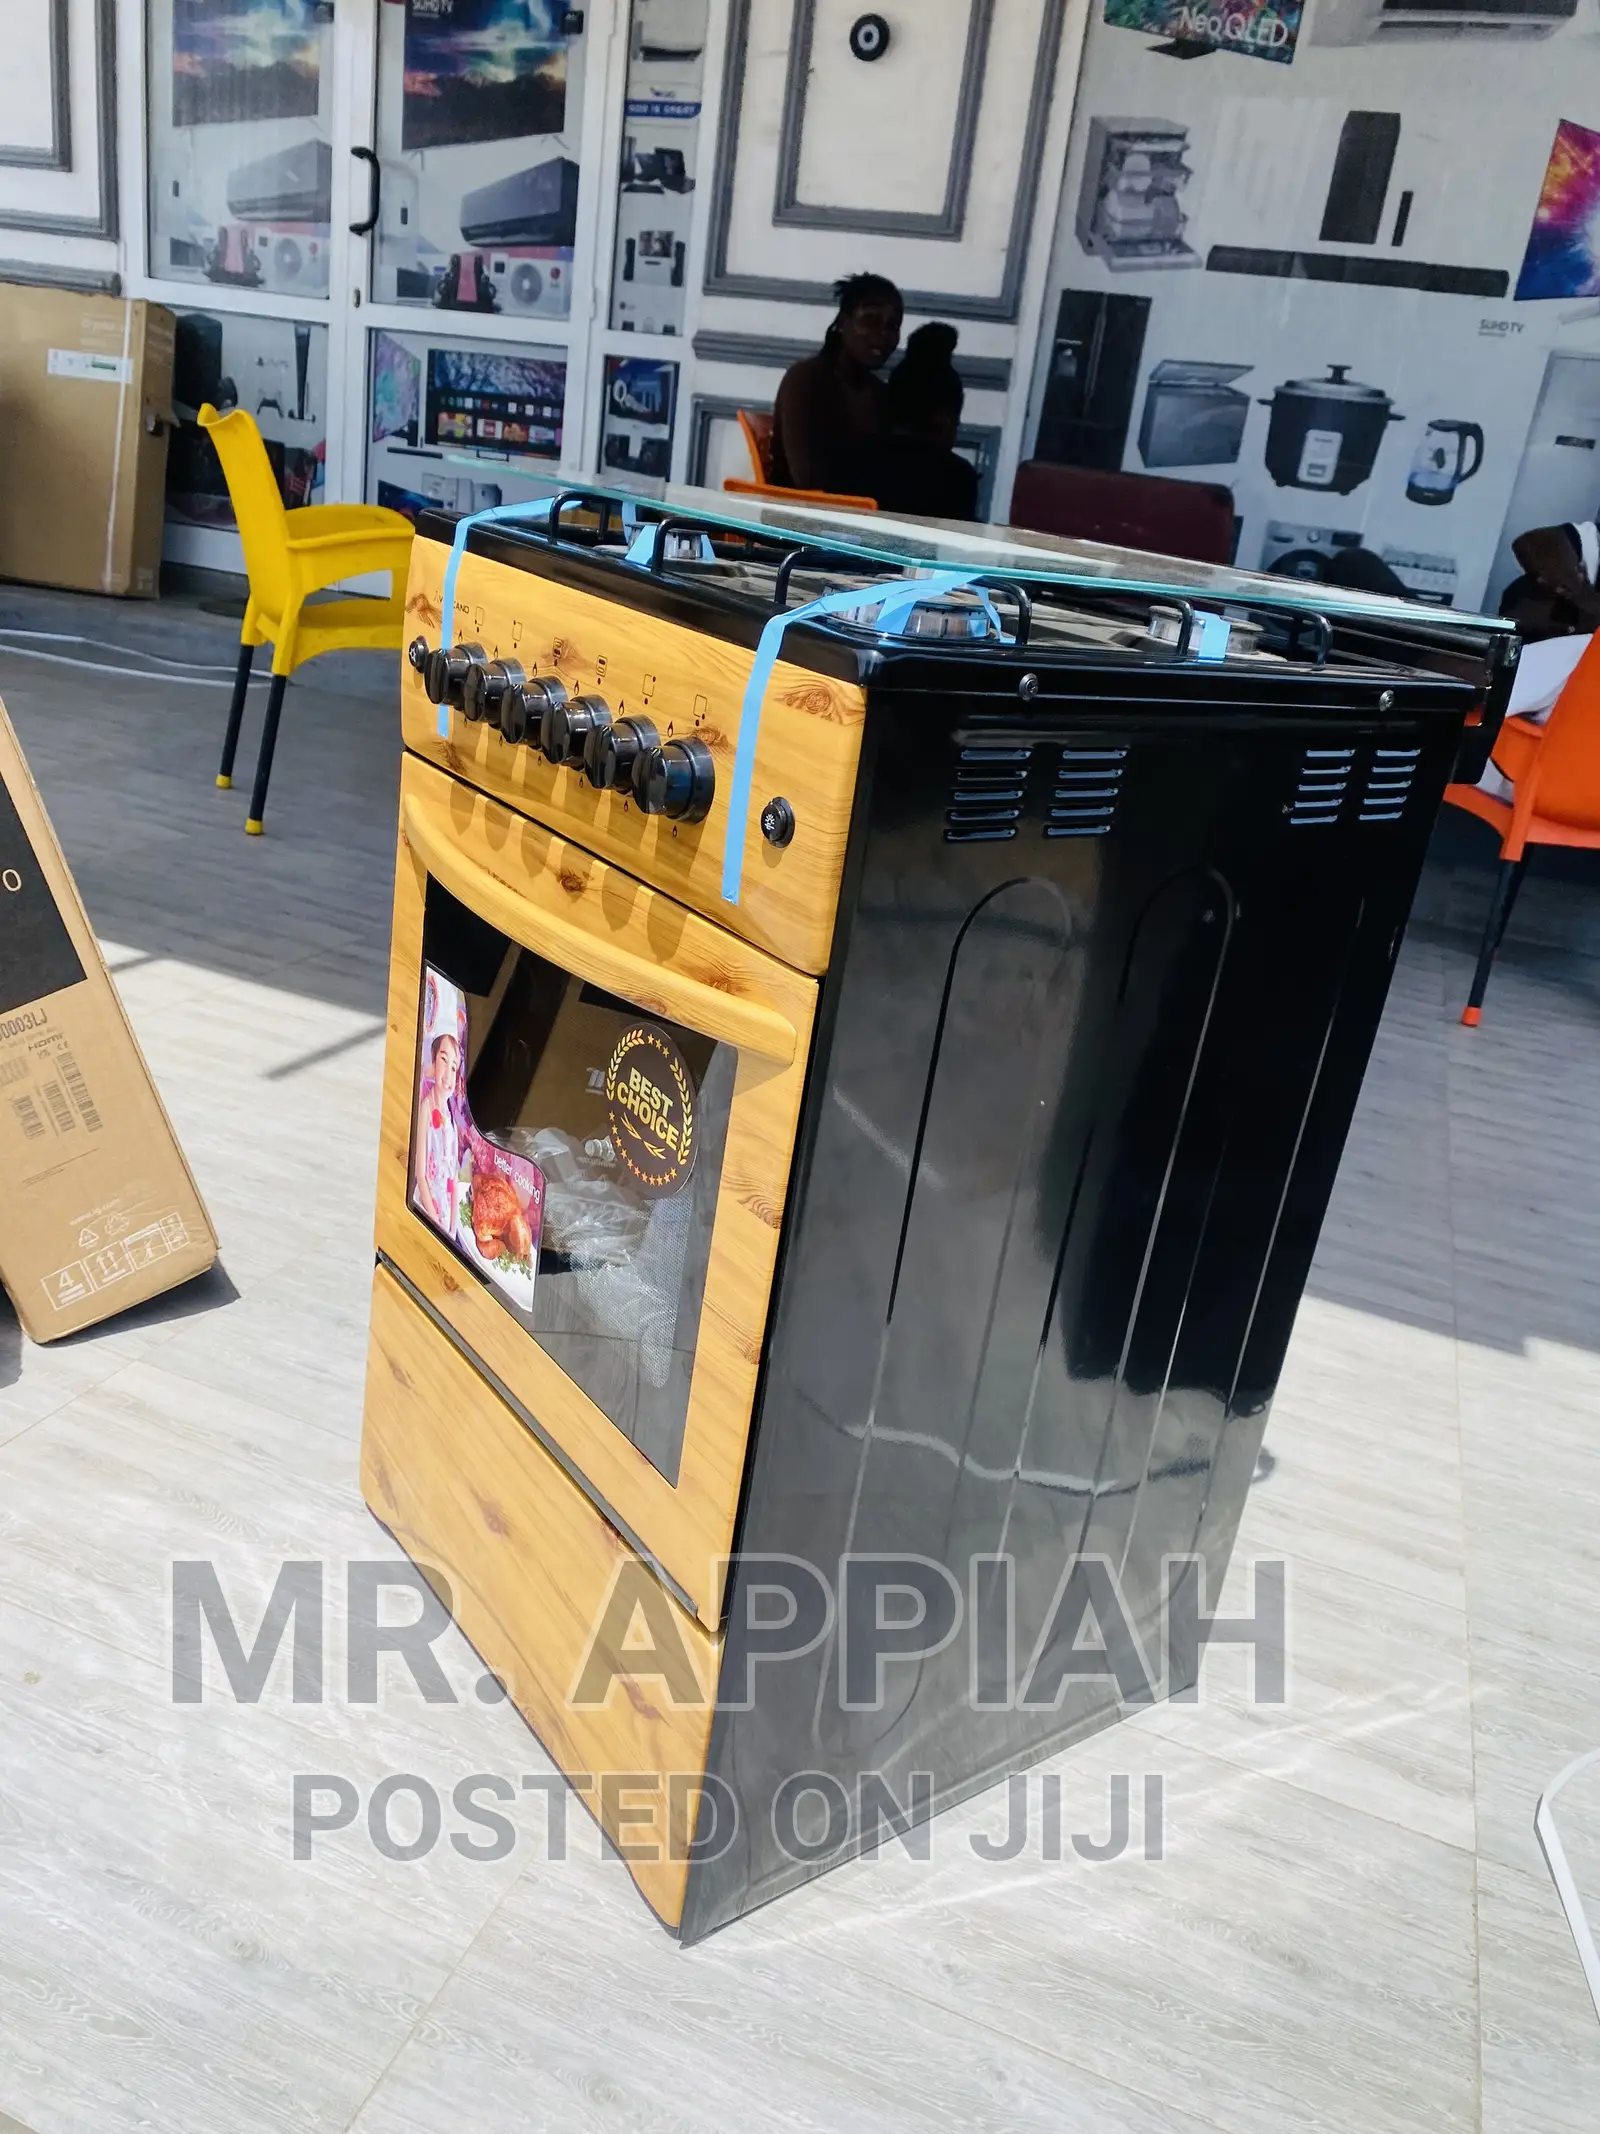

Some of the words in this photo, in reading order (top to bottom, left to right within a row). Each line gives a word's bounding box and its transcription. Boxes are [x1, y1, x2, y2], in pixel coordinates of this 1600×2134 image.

[1223, 12, 1289, 48] QLED
[0, 1007, 48, 1042] 0003LJ
[616, 1081, 680, 1151] CHOICE
[629, 1066, 674, 1118] BEST
[494, 1150, 513, 1176] better
[514, 1171, 541, 1204] cooking
